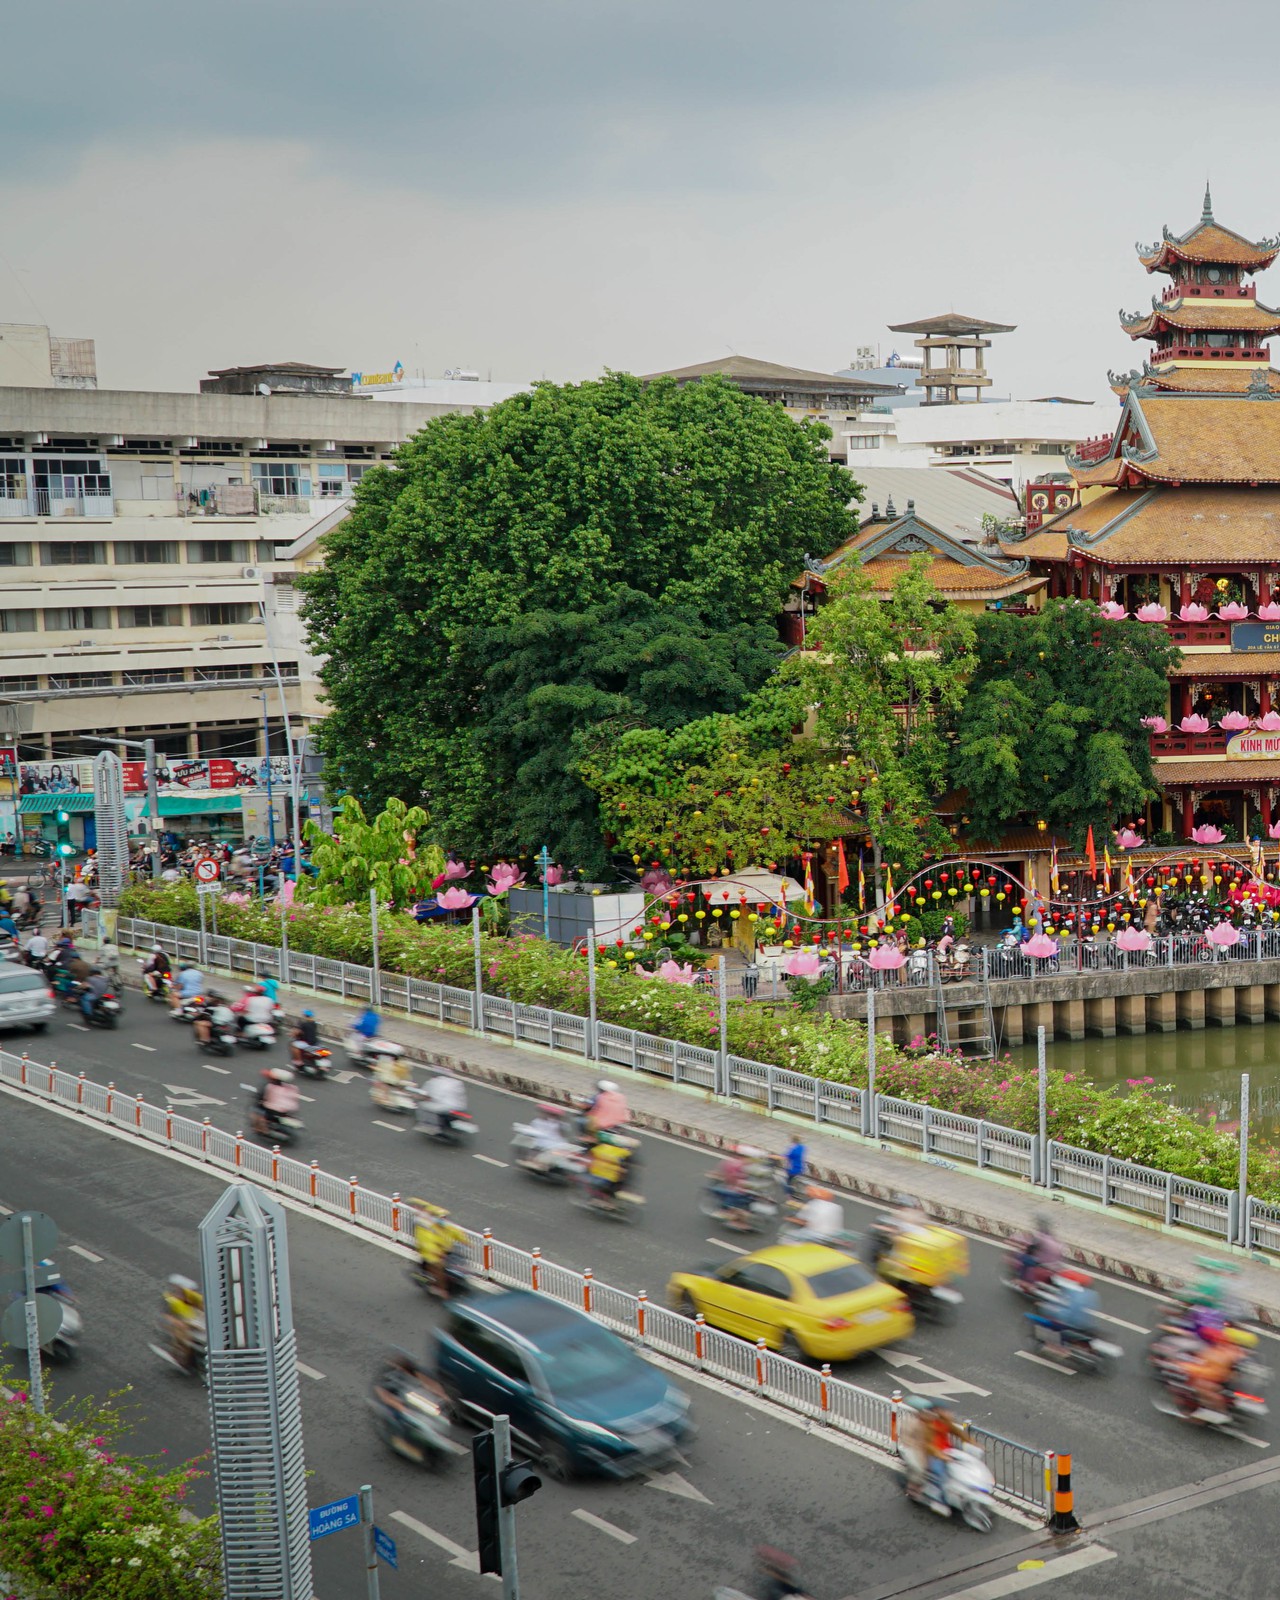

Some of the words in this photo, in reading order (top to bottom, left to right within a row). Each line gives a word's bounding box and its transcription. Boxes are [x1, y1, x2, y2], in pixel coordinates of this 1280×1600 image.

[320, 1503, 348, 1518] ĐƯỜNG
[312, 1518, 342, 1536] HOÀNG
[345, 1513, 356, 1524] SA
